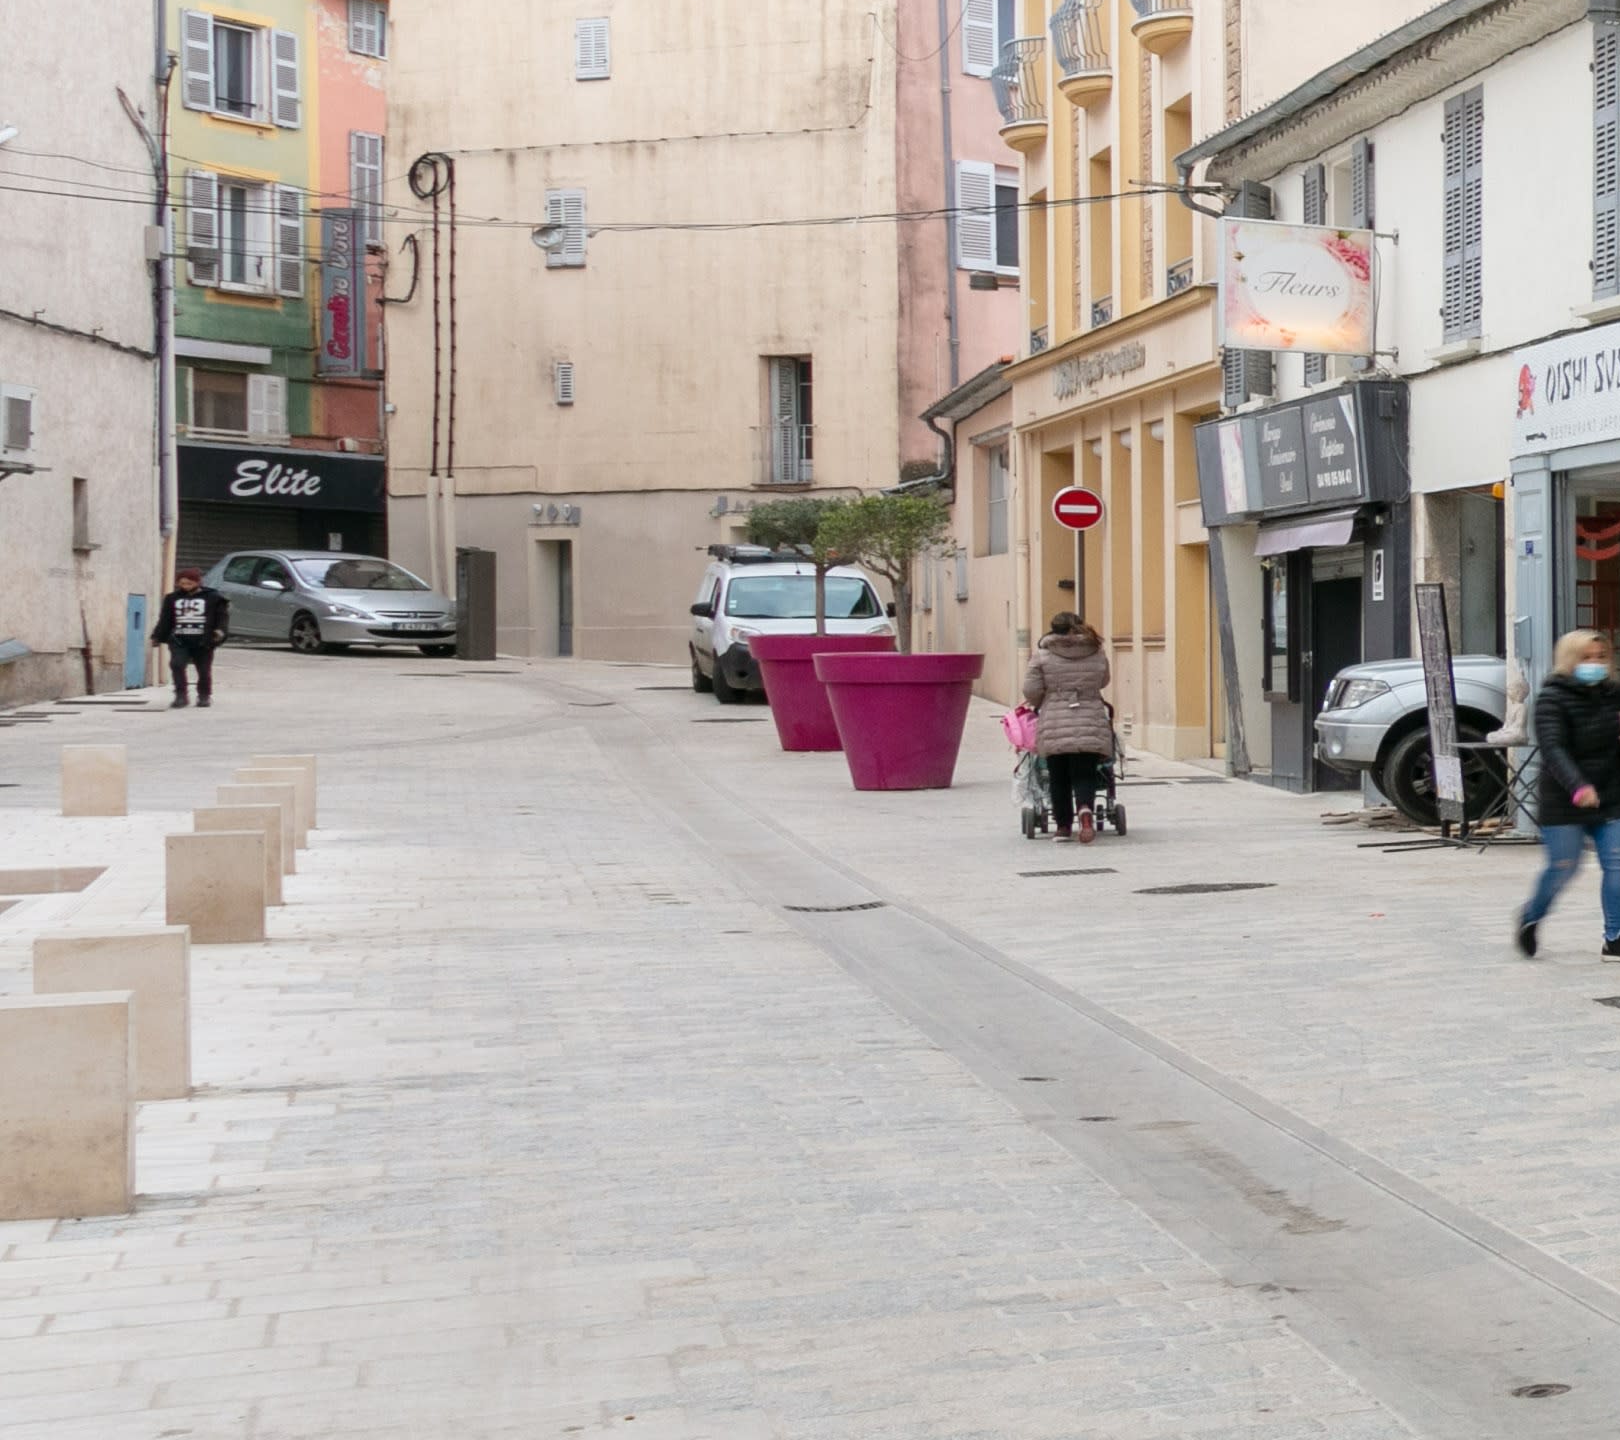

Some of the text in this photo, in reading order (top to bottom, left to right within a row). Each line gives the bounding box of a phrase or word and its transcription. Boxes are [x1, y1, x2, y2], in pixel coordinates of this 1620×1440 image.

[1254, 271, 1340, 297] Fleurs
[1545, 356, 1587, 404] OISHI
[230, 459, 321, 497] Elite
